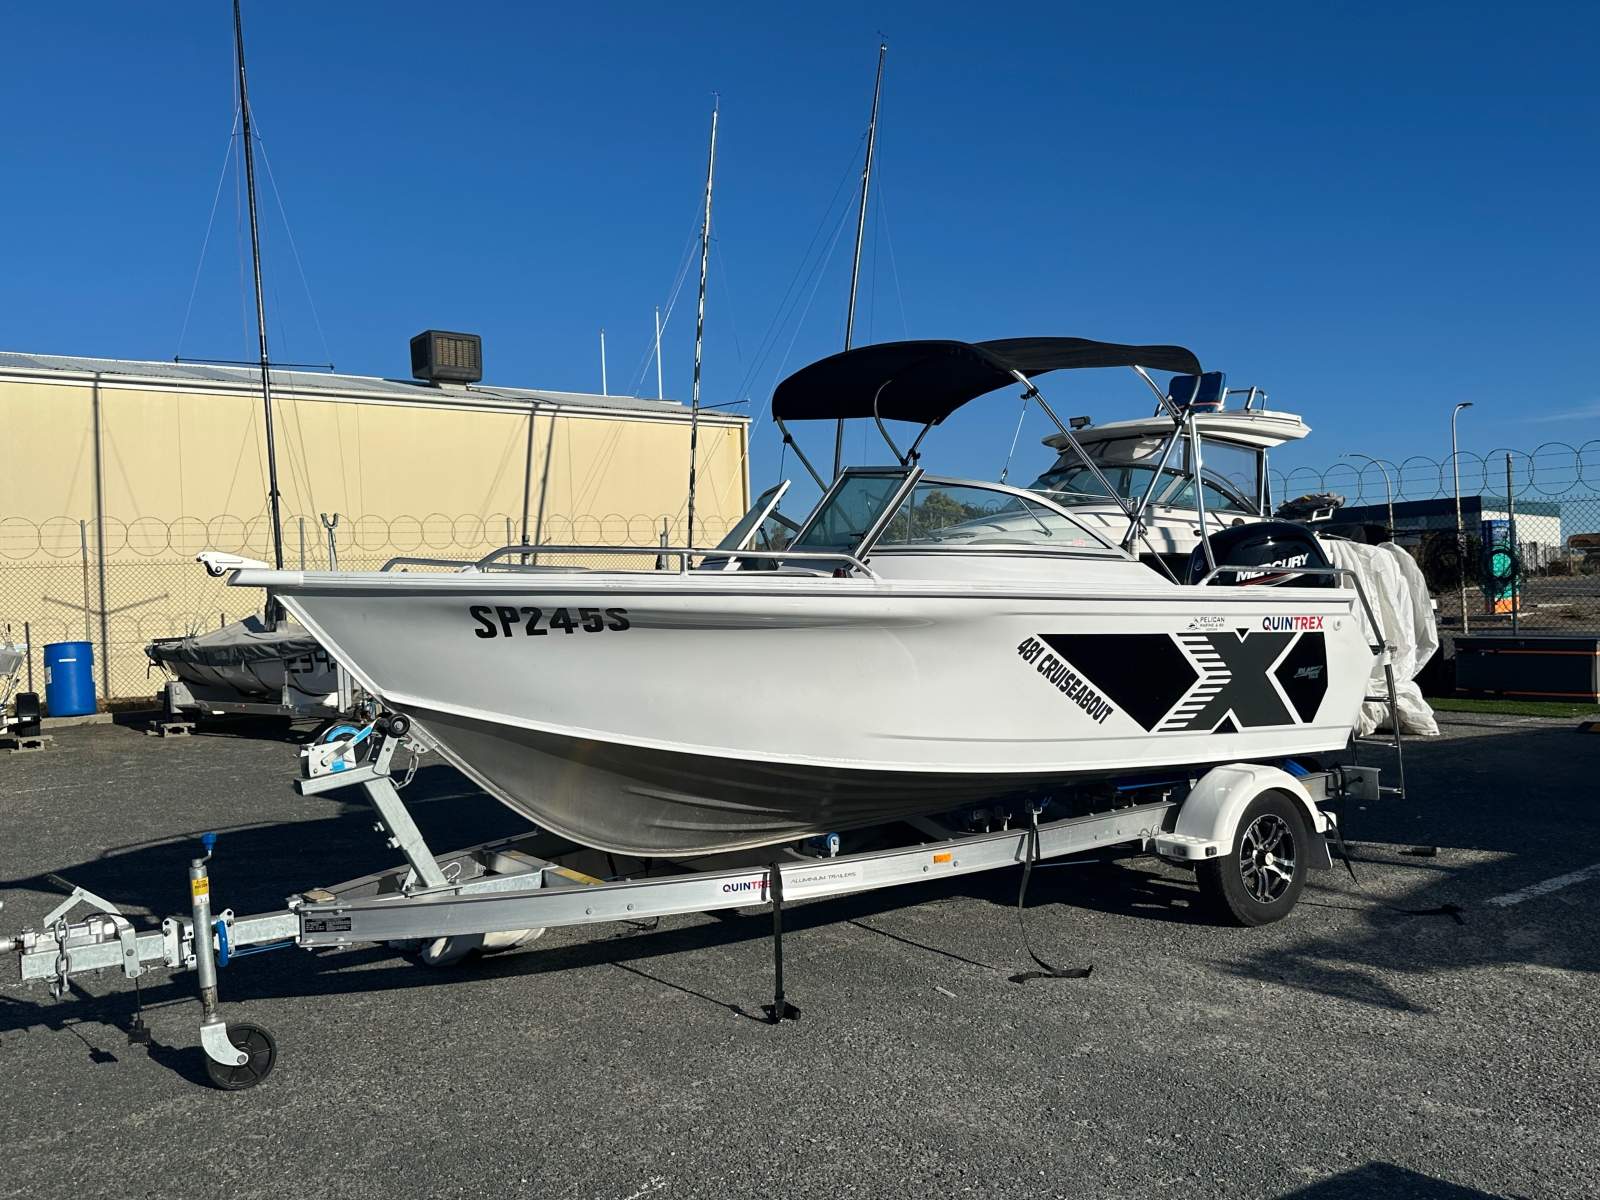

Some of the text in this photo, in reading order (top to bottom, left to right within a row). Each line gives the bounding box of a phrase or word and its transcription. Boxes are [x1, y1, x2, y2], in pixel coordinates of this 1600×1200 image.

[469, 605, 631, 639] SP245S
[1262, 616, 1324, 631] QUINTREX
[1017, 637, 1114, 724] 481 CRUISEABOUT
[722, 880, 773, 893] QUINTRE
